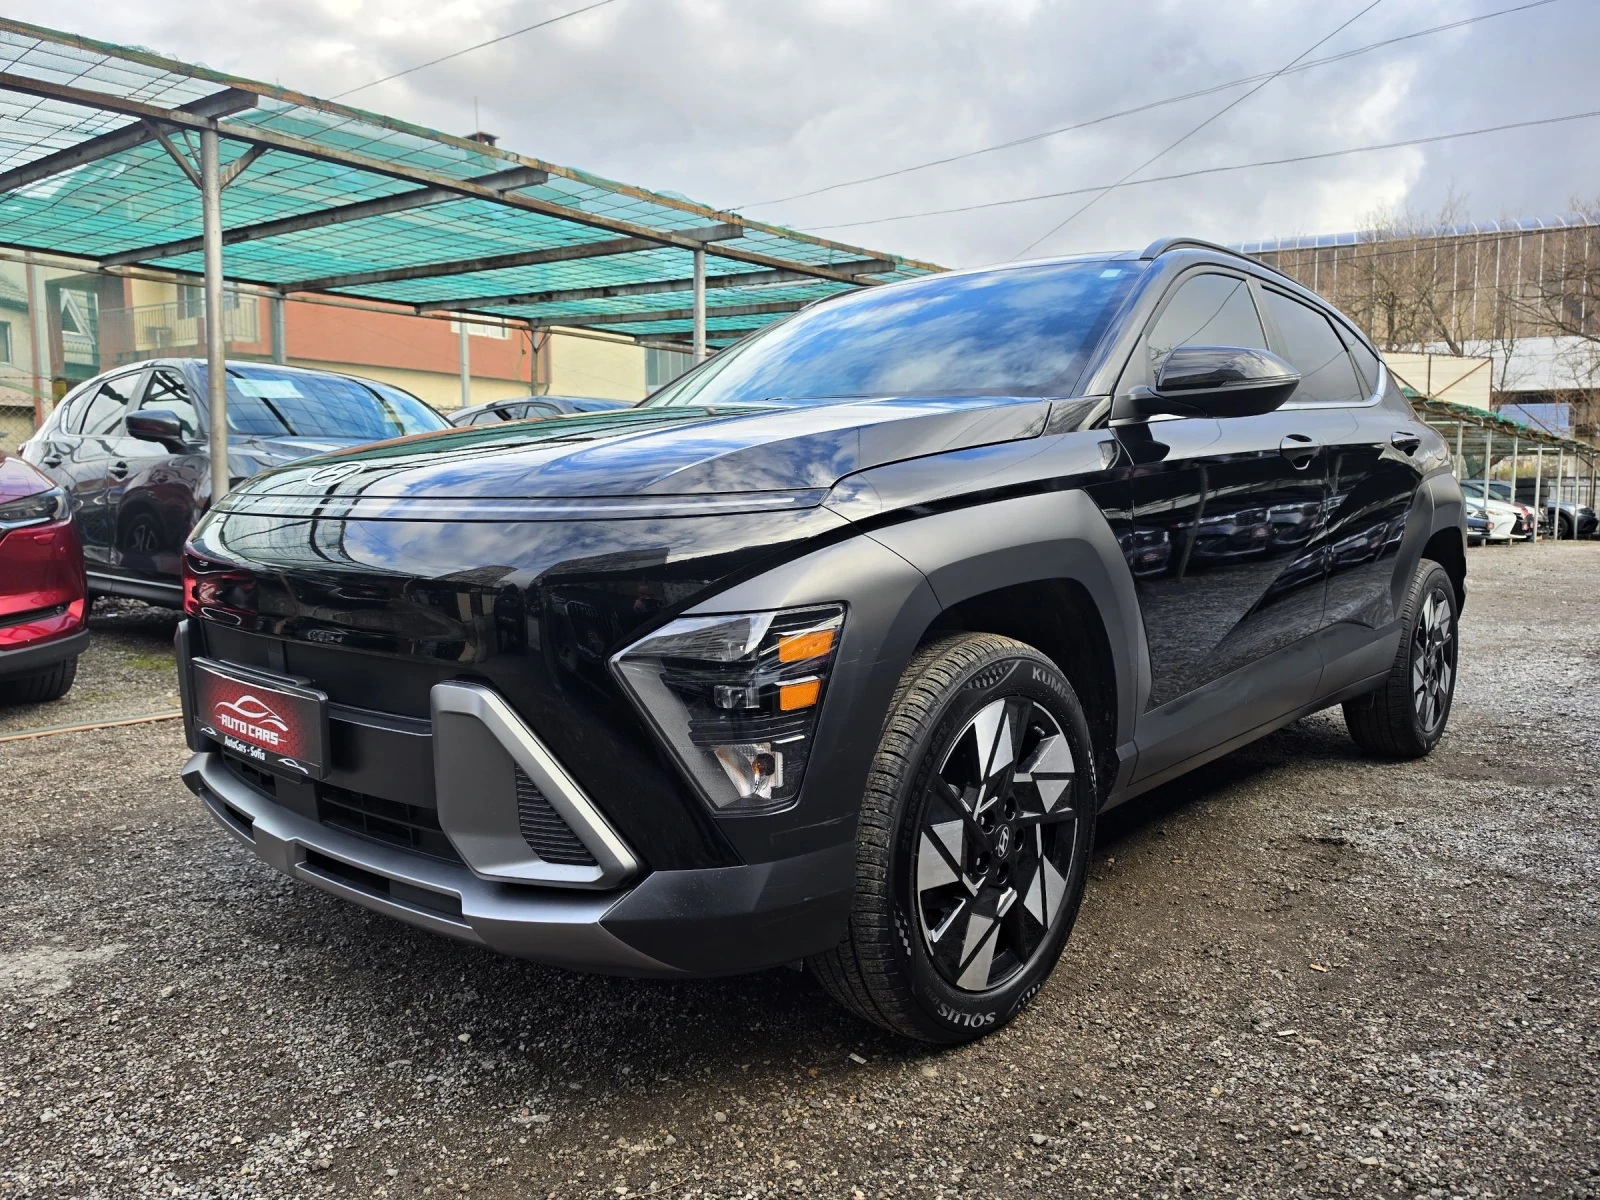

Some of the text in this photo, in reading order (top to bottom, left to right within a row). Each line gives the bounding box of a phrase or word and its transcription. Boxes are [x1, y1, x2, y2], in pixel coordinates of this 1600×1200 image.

[221, 713, 279, 745] AUTO CARS
[224, 735, 247, 754] AutoCars
[250, 746, 266, 761] Sofia
[937, 1002, 996, 1028] SOLUS
